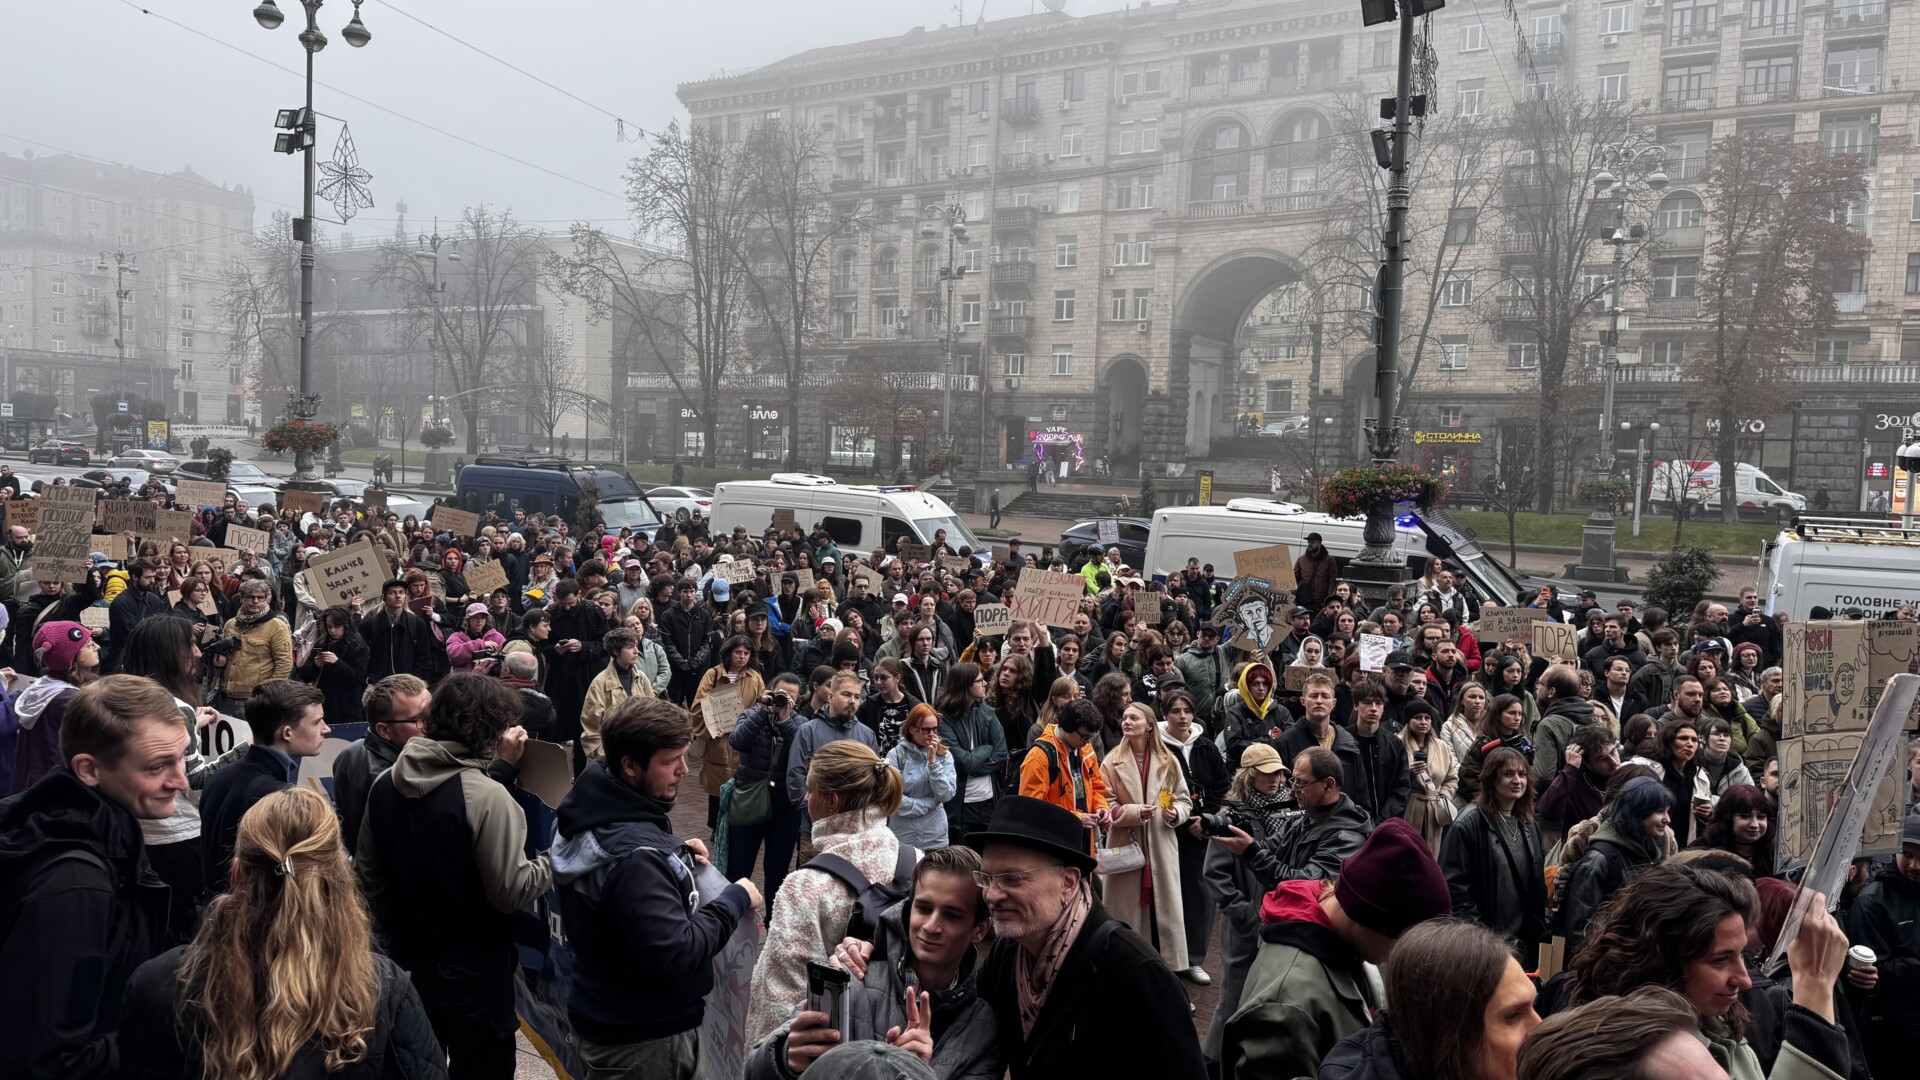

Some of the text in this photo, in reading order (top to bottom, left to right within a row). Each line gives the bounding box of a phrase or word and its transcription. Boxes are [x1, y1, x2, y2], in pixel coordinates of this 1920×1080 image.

[1426, 432, 1482, 440] СТОЛИЧНА
[231, 529, 265, 553] ПОРА
[324, 556, 364, 577] КЛИЧКО
[326, 575, 354, 590] УДАР
[1142, 603, 1155, 612] ДЕ
[1835, 594, 1901, 608] ГОЛОВНЕ
[976, 608, 1009, 623] ПОРА
[1010, 594, 1078, 624] ЖИТТЯ
[1497, 617, 1503, 626] Я
[1499, 624, 1518, 633] СВІЙ
[1510, 632, 1532, 640] НАЗА
[1534, 625, 1577, 656] ПОРА
[1805, 629, 1832, 651] РОБИ
[1805, 652, 1834, 675] ВЖЕ
